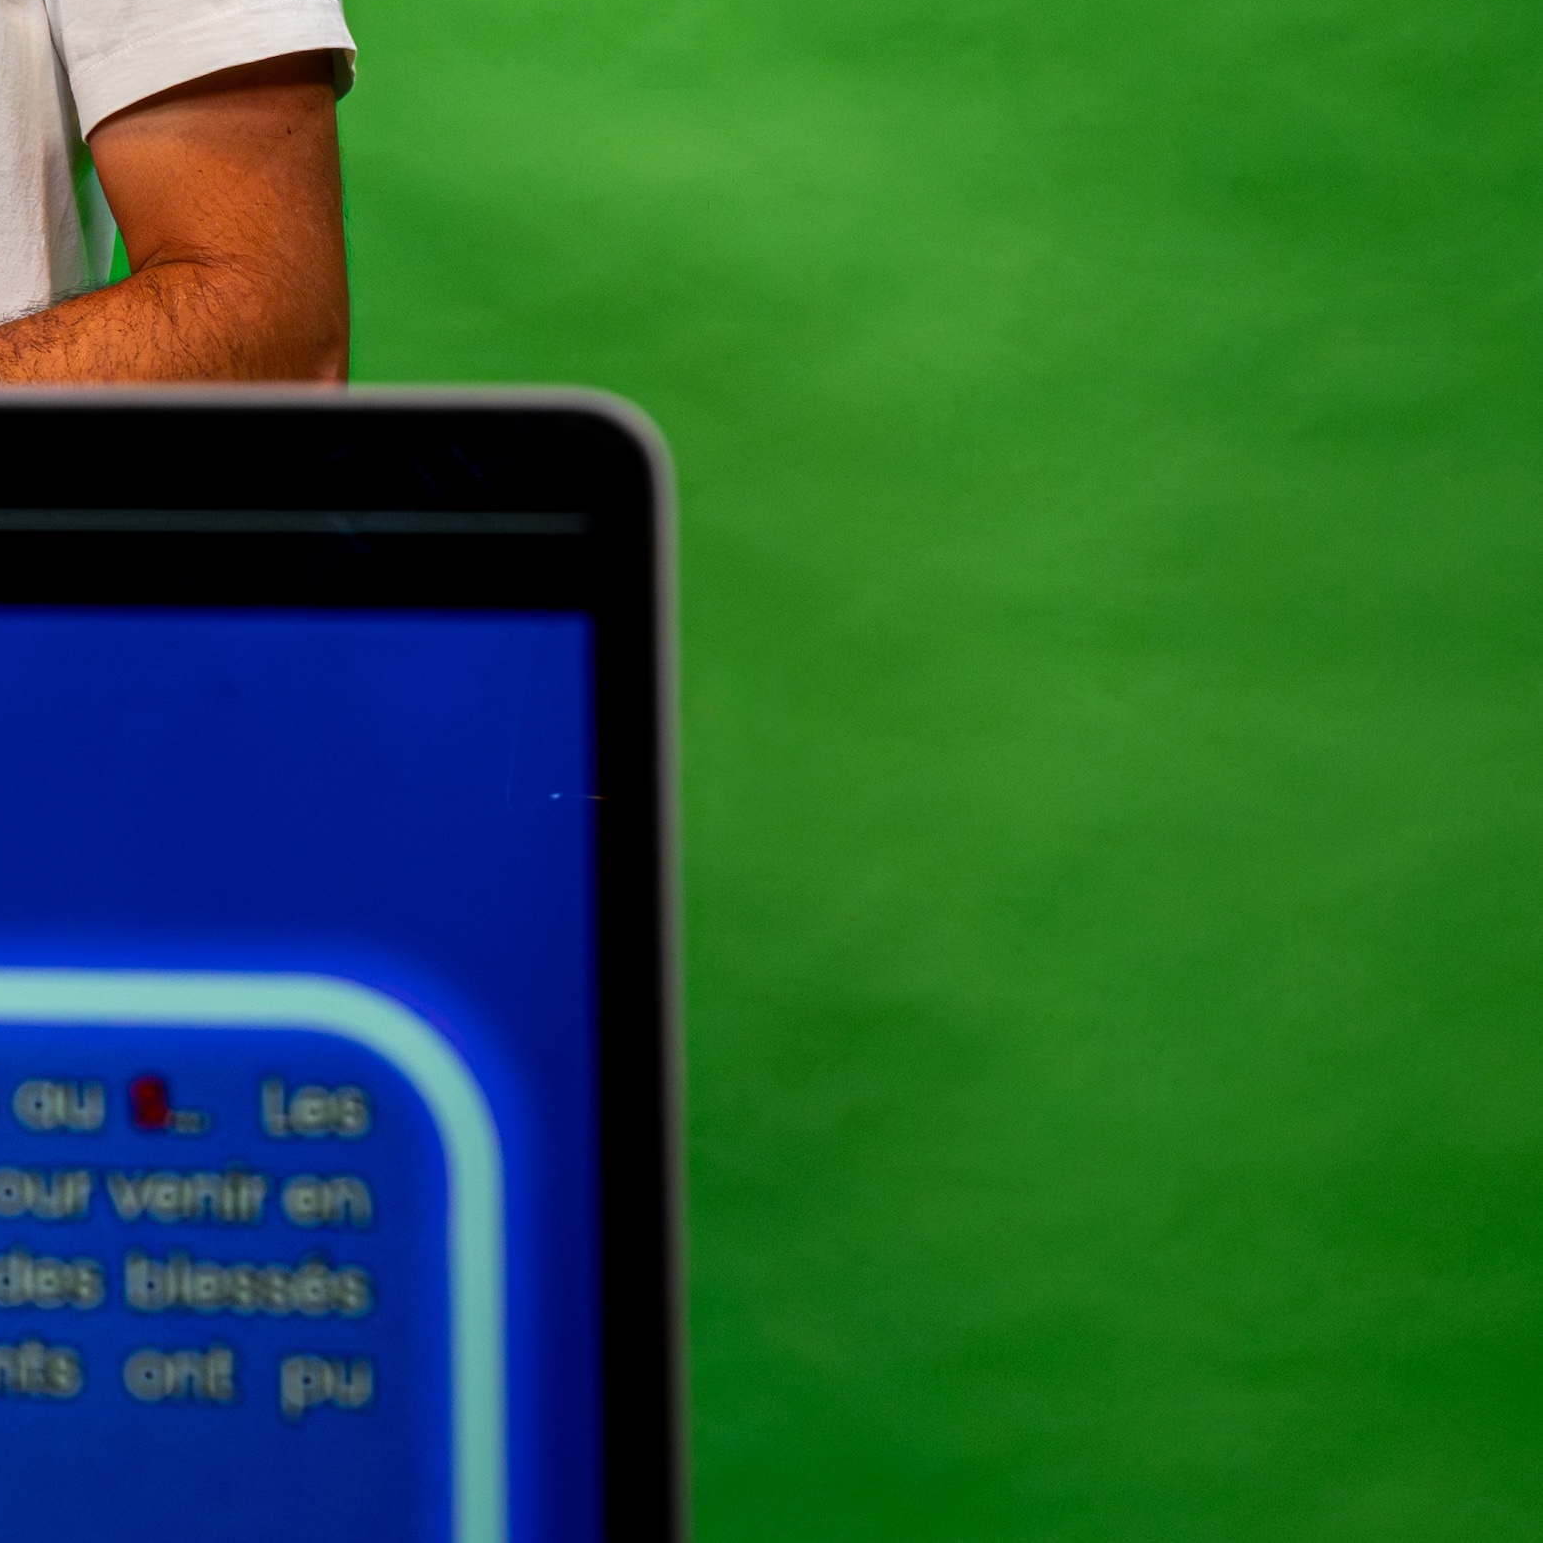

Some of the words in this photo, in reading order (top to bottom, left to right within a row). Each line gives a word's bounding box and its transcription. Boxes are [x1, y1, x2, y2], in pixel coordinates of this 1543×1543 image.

[13, 1078, 105, 1132] au
[260, 1078, 371, 1137] Les
[108, 1162, 267, 1224] venir
[282, 1175, 372, 1227] en
[125, 1249, 372, 1315] blessés
[123, 1343, 236, 1404] ont
[280, 1353, 373, 1421] pu
